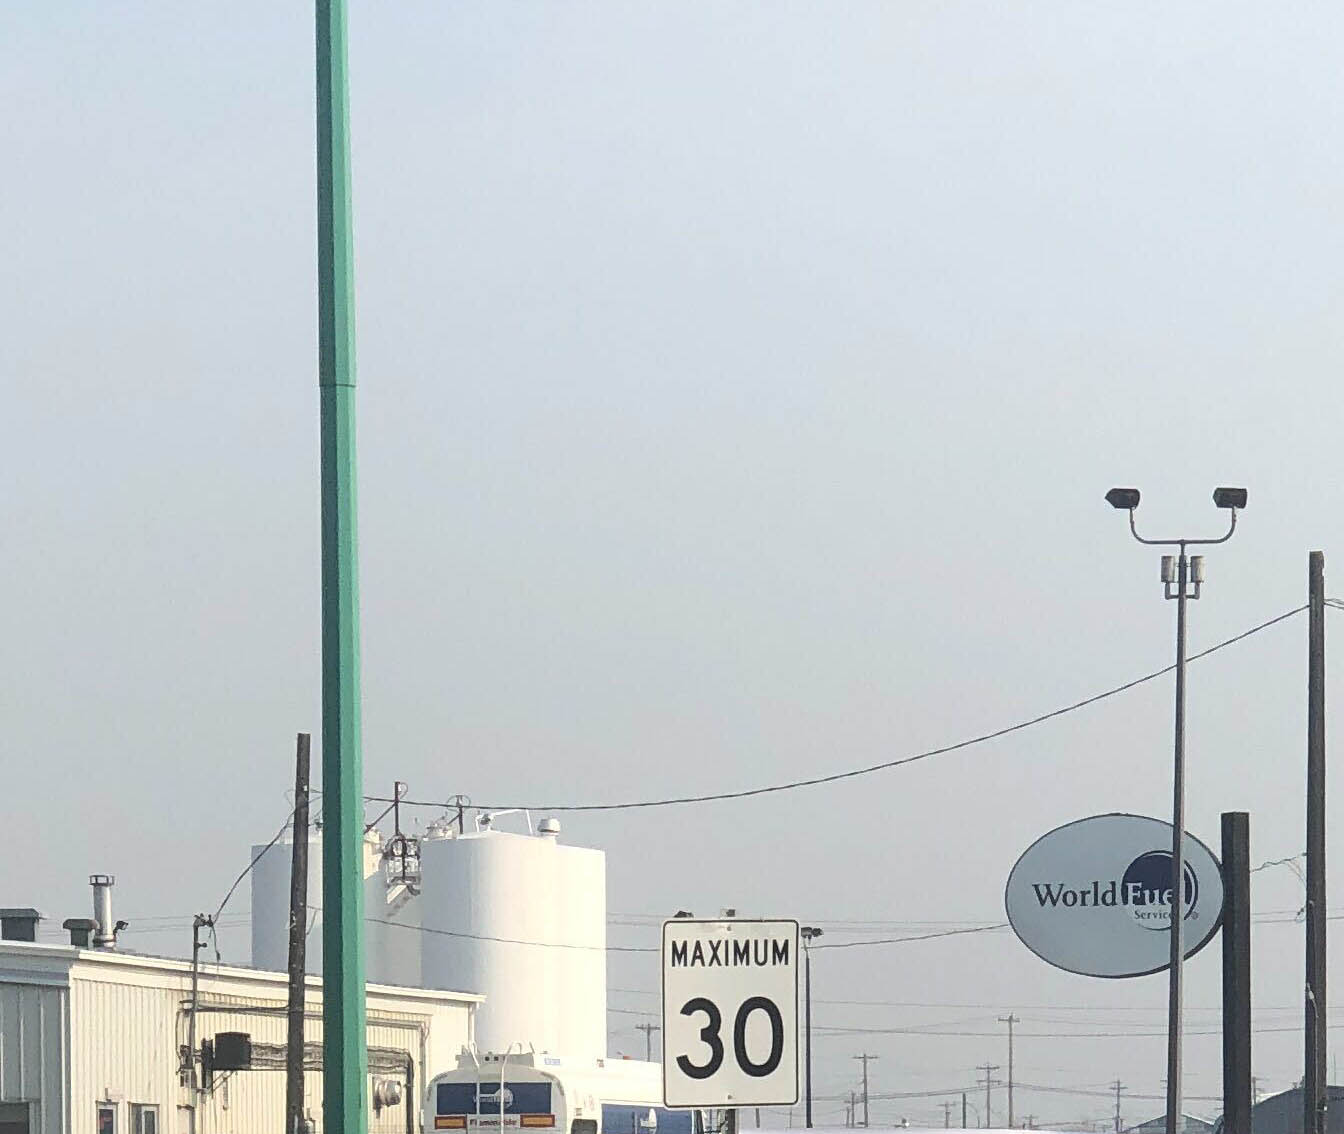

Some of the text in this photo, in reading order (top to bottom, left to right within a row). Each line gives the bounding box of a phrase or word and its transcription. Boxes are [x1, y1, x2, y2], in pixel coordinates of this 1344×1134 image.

[1032, 881, 1178, 907] World Fue
[670, 939, 790, 967] MAXIMUM
[676, 996, 785, 1080] 30
